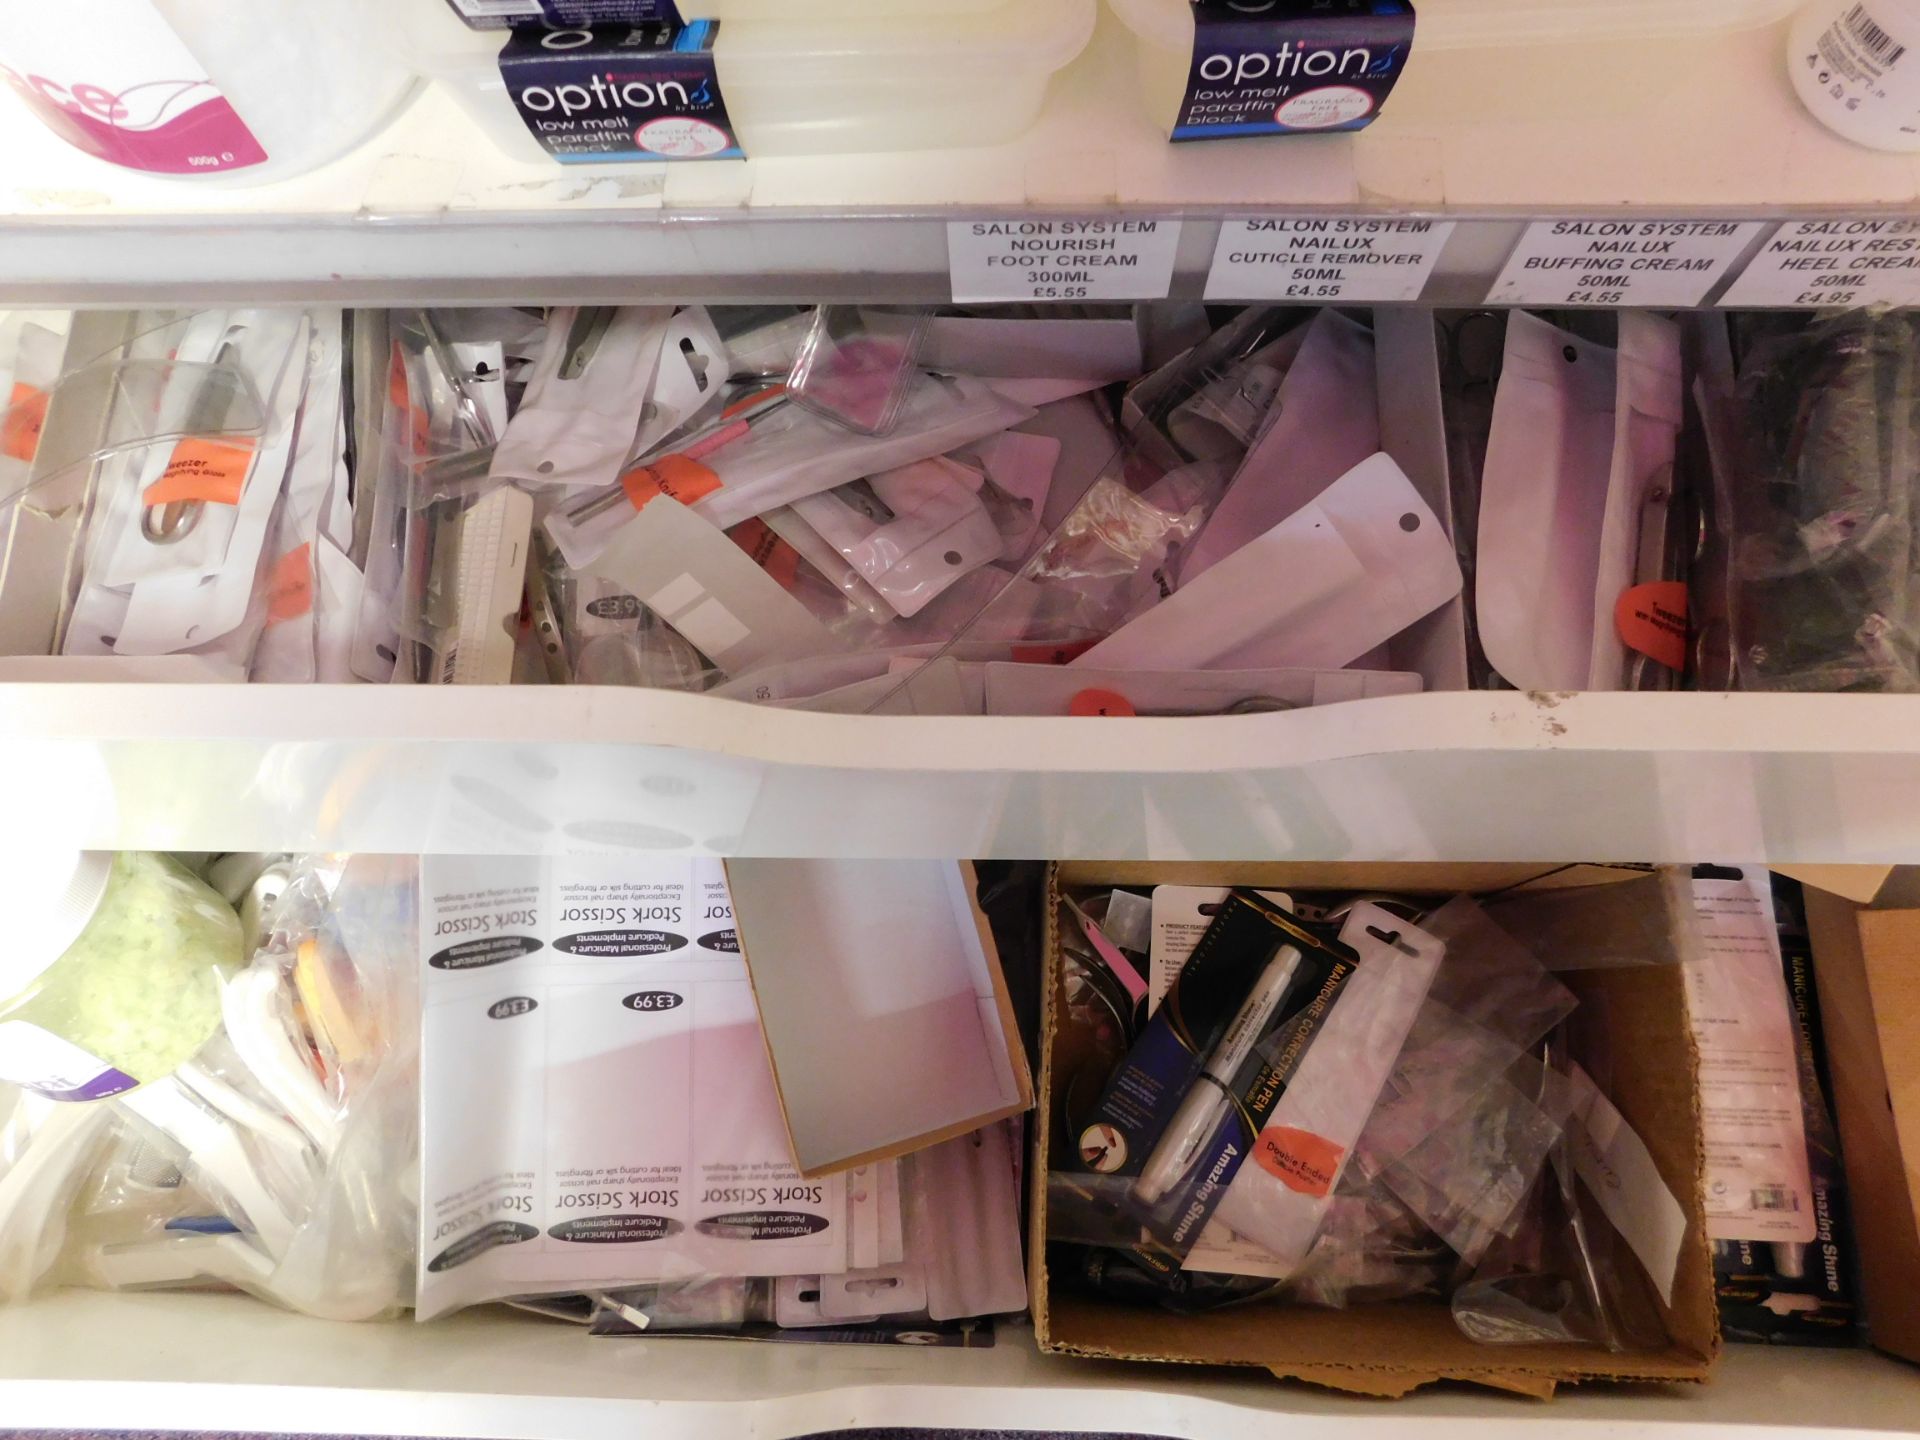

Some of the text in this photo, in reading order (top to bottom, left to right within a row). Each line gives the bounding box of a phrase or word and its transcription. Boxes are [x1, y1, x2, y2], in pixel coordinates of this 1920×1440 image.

[1200, 40, 1371, 86] option
[521, 73, 689, 117] option
[1194, 85, 1290, 100] low melt
[1189, 100, 1276, 115] paraffin
[535, 116, 630, 131] low melt
[1186, 113, 1246, 125] block
[546, 130, 631, 145] paraffin
[972, 222, 1157, 236] SALON SYSTEM
[1246, 220, 1432, 233] SALON SYSTEM
[1551, 223, 1740, 236] SALON SYSTEM
[1796, 221, 1887, 235] SALON
[1011, 239, 1116, 251] NOURISH
[1289, 237, 1376, 249] NAILUX
[1587, 240, 1678, 253] NAILUX
[1768, 239, 1920, 252] NAILUX RES
[987, 255, 1138, 267] FOOT CREAM
[1229, 252, 1423, 265] CUTICLE REMOVER
[1523, 257, 1715, 271] BUFFING CREAM
[1779, 257, 1841, 270] HEEL
[1028, 271, 1095, 283] 300ML
[1291, 268, 1347, 281] 50ML
[1577, 275, 1632, 287] 50ML
[1810, 275, 1868, 287] 50ML
[1033, 287, 1087, 298] £5.55
[1285, 285, 1342, 297] £4.55
[1566, 291, 1624, 303] £4.55
[1794, 292, 1856, 304] £4.95
[168, 459, 208, 469] weezer
[560, 907, 682, 924] Stork Scissor
[434, 909, 537, 936] Stork Scissor
[576, 932, 665, 942] Pedicure Implements
[570, 943, 671, 954] Professional Manicure &
[713, 942, 721, 950] &
[1306, 962, 1346, 1019] MANICURE
[1789, 955, 1811, 1019] MANICURE
[633, 994, 675, 1009] £3.99
[1266, 1017, 1315, 1088] CORRECTION
[1250, 1086, 1273, 1113] PEN
[1266, 1141, 1330, 1184] Double Ended
[701, 1186, 822, 1205] Stork Scissor
[1171, 1140, 1240, 1245] Amazing Shine
[555, 1190, 679, 1209] Stork Scissor
[1808, 1173, 1838, 1242] Amazing
[572, 1218, 662, 1228] Pedicure Implements
[769, 1214, 806, 1224] Pedicure
[565, 1229, 669, 1241] Professional Manicure &
[761, 1226, 812, 1236] Professional
[1820, 1241, 1845, 1292] Shine
